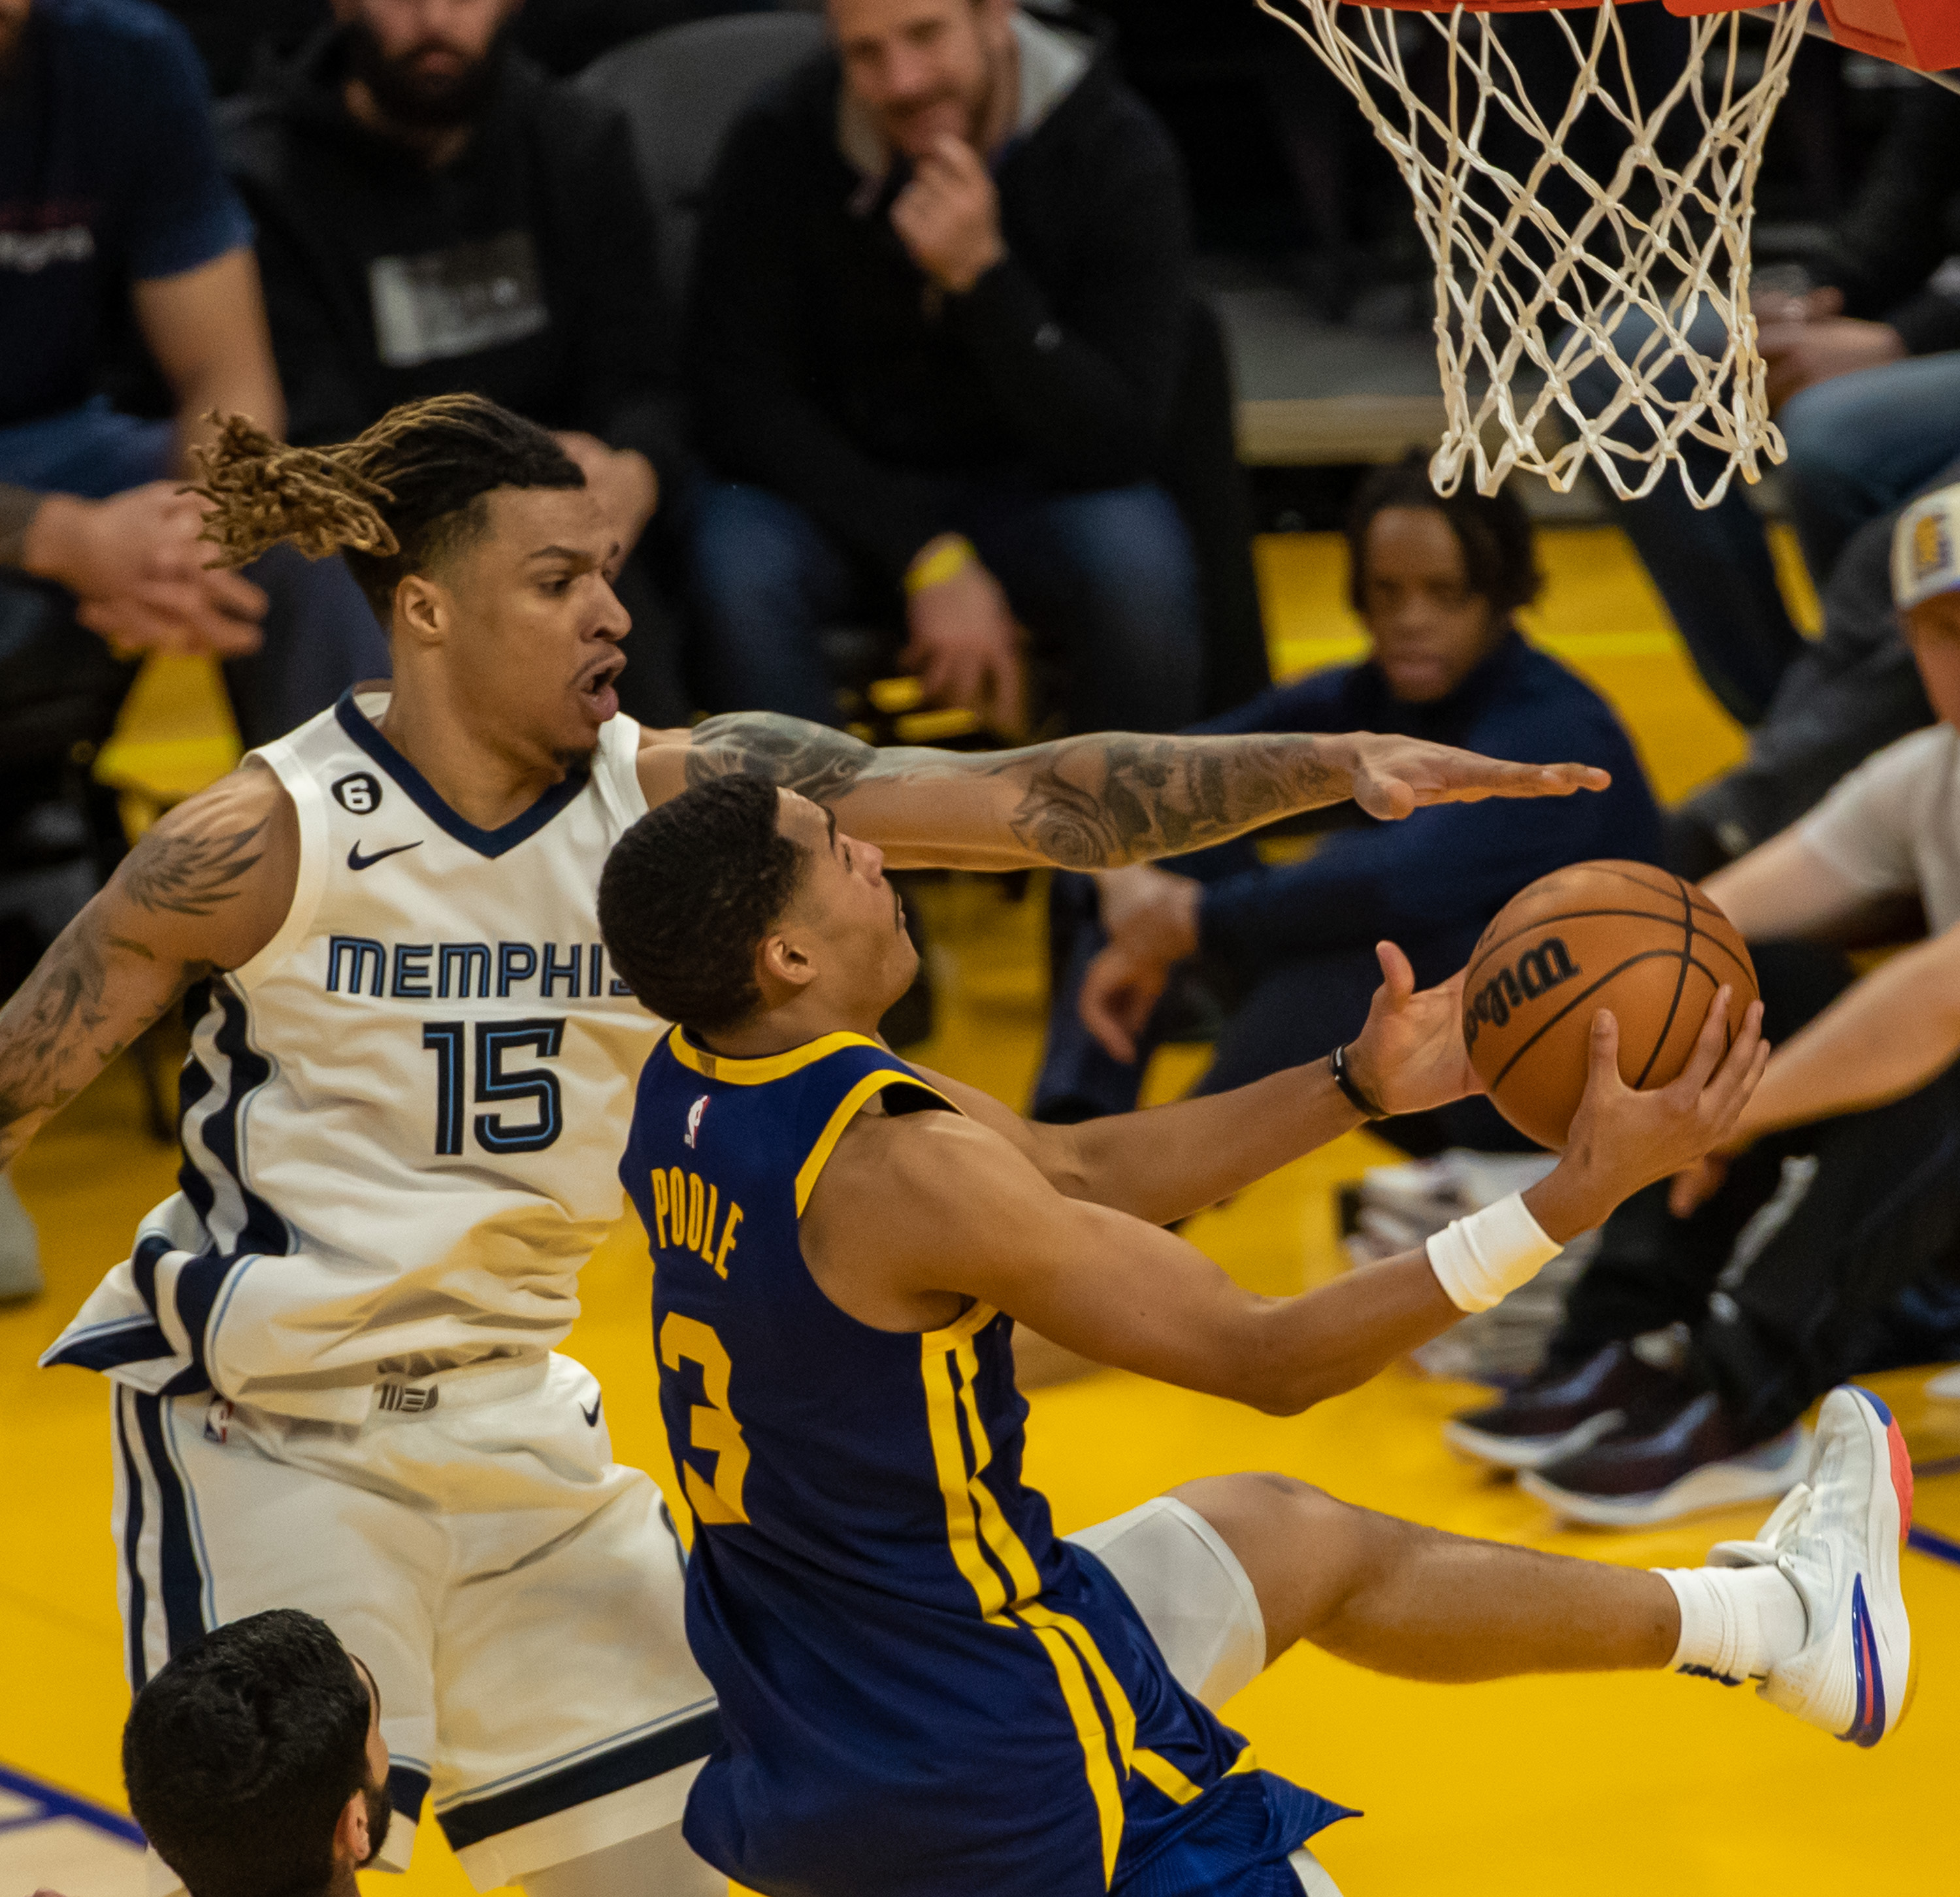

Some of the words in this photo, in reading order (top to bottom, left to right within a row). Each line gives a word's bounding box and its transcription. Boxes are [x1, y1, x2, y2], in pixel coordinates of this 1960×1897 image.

[342, 778, 372, 810] 6
[326, 934, 638, 998] MEMPHI
[1462, 936, 1582, 1057] Wilso
[422, 1017, 567, 1156] 15
[651, 1166, 744, 1280] POOLE
[659, 1311, 751, 1525] 3
